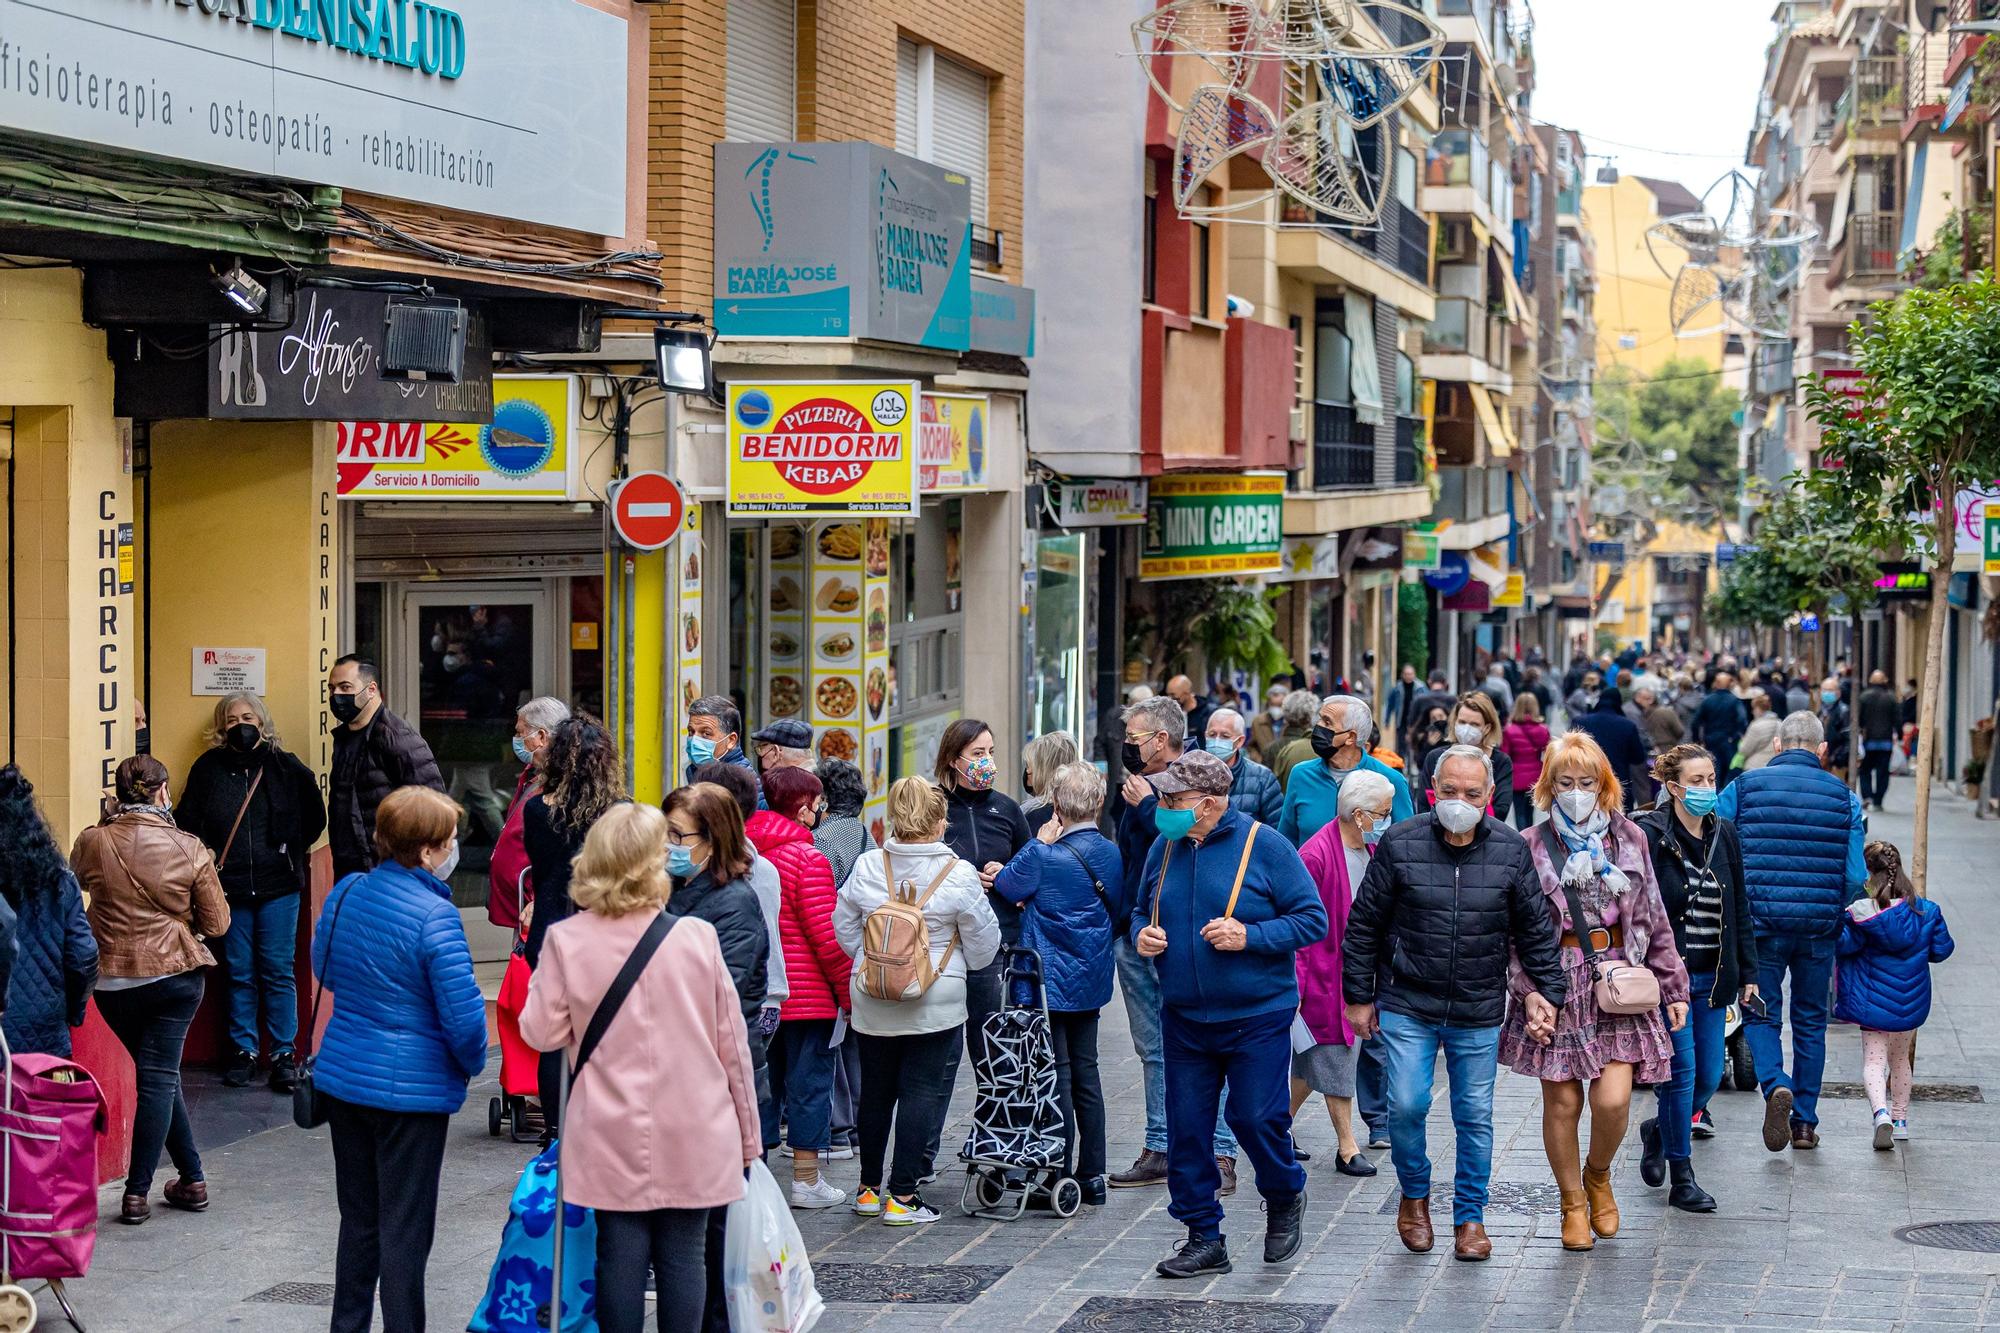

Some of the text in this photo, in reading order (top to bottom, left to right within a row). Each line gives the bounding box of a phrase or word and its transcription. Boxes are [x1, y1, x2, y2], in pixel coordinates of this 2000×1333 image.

[1, 43, 494, 188] fisioterapia osteopatía rehabilitación
[728, 280, 791, 294] BAREA
[887, 256, 923, 296] BAREA
[279, 290, 373, 406] Alfonso
[782, 406, 864, 431] PIZZERIA
[877, 413, 900, 421] HALAL
[742, 435, 899, 458] BENIDORM
[374, 473, 480, 487] Servicio A Domicilio
[785, 462, 863, 485] KEBAB
[848, 503, 874, 511] Servicio
[881, 503, 909, 511] Domicilio
[1069, 484, 1129, 514] AK ESPAÑA
[1166, 504, 1281, 547] MINI GARDEN
